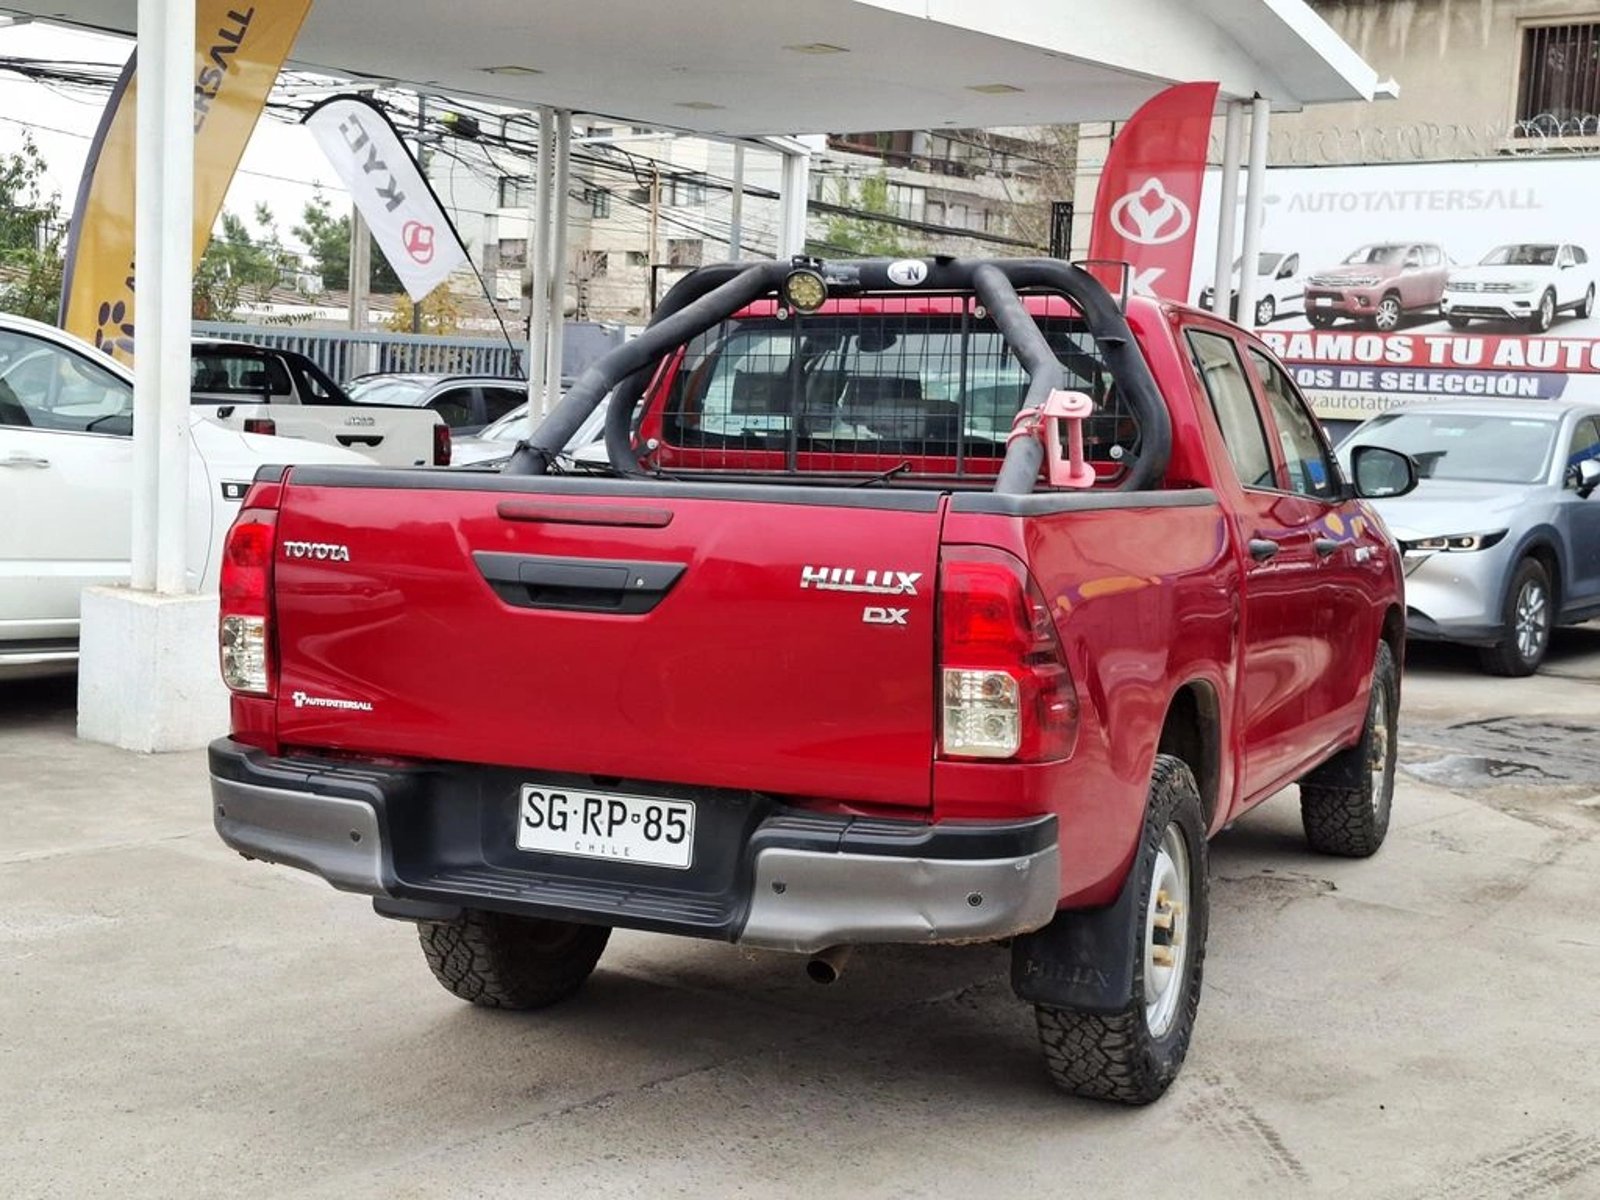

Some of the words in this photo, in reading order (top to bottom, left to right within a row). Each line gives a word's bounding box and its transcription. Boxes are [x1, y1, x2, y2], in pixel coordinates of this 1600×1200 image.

[1287, 188, 1543, 214] AUTOTATTERSALL
[1425, 337, 1484, 365] TU
[1340, 371, 1374, 389] DE
[1380, 371, 1539, 397] SELECCIÓN
[283, 541, 350, 562] TOYOTA
[800, 565, 922, 595] HILUX
[863, 606, 910, 625] DX
[305, 697, 373, 711] AUTOTATTERSALL
